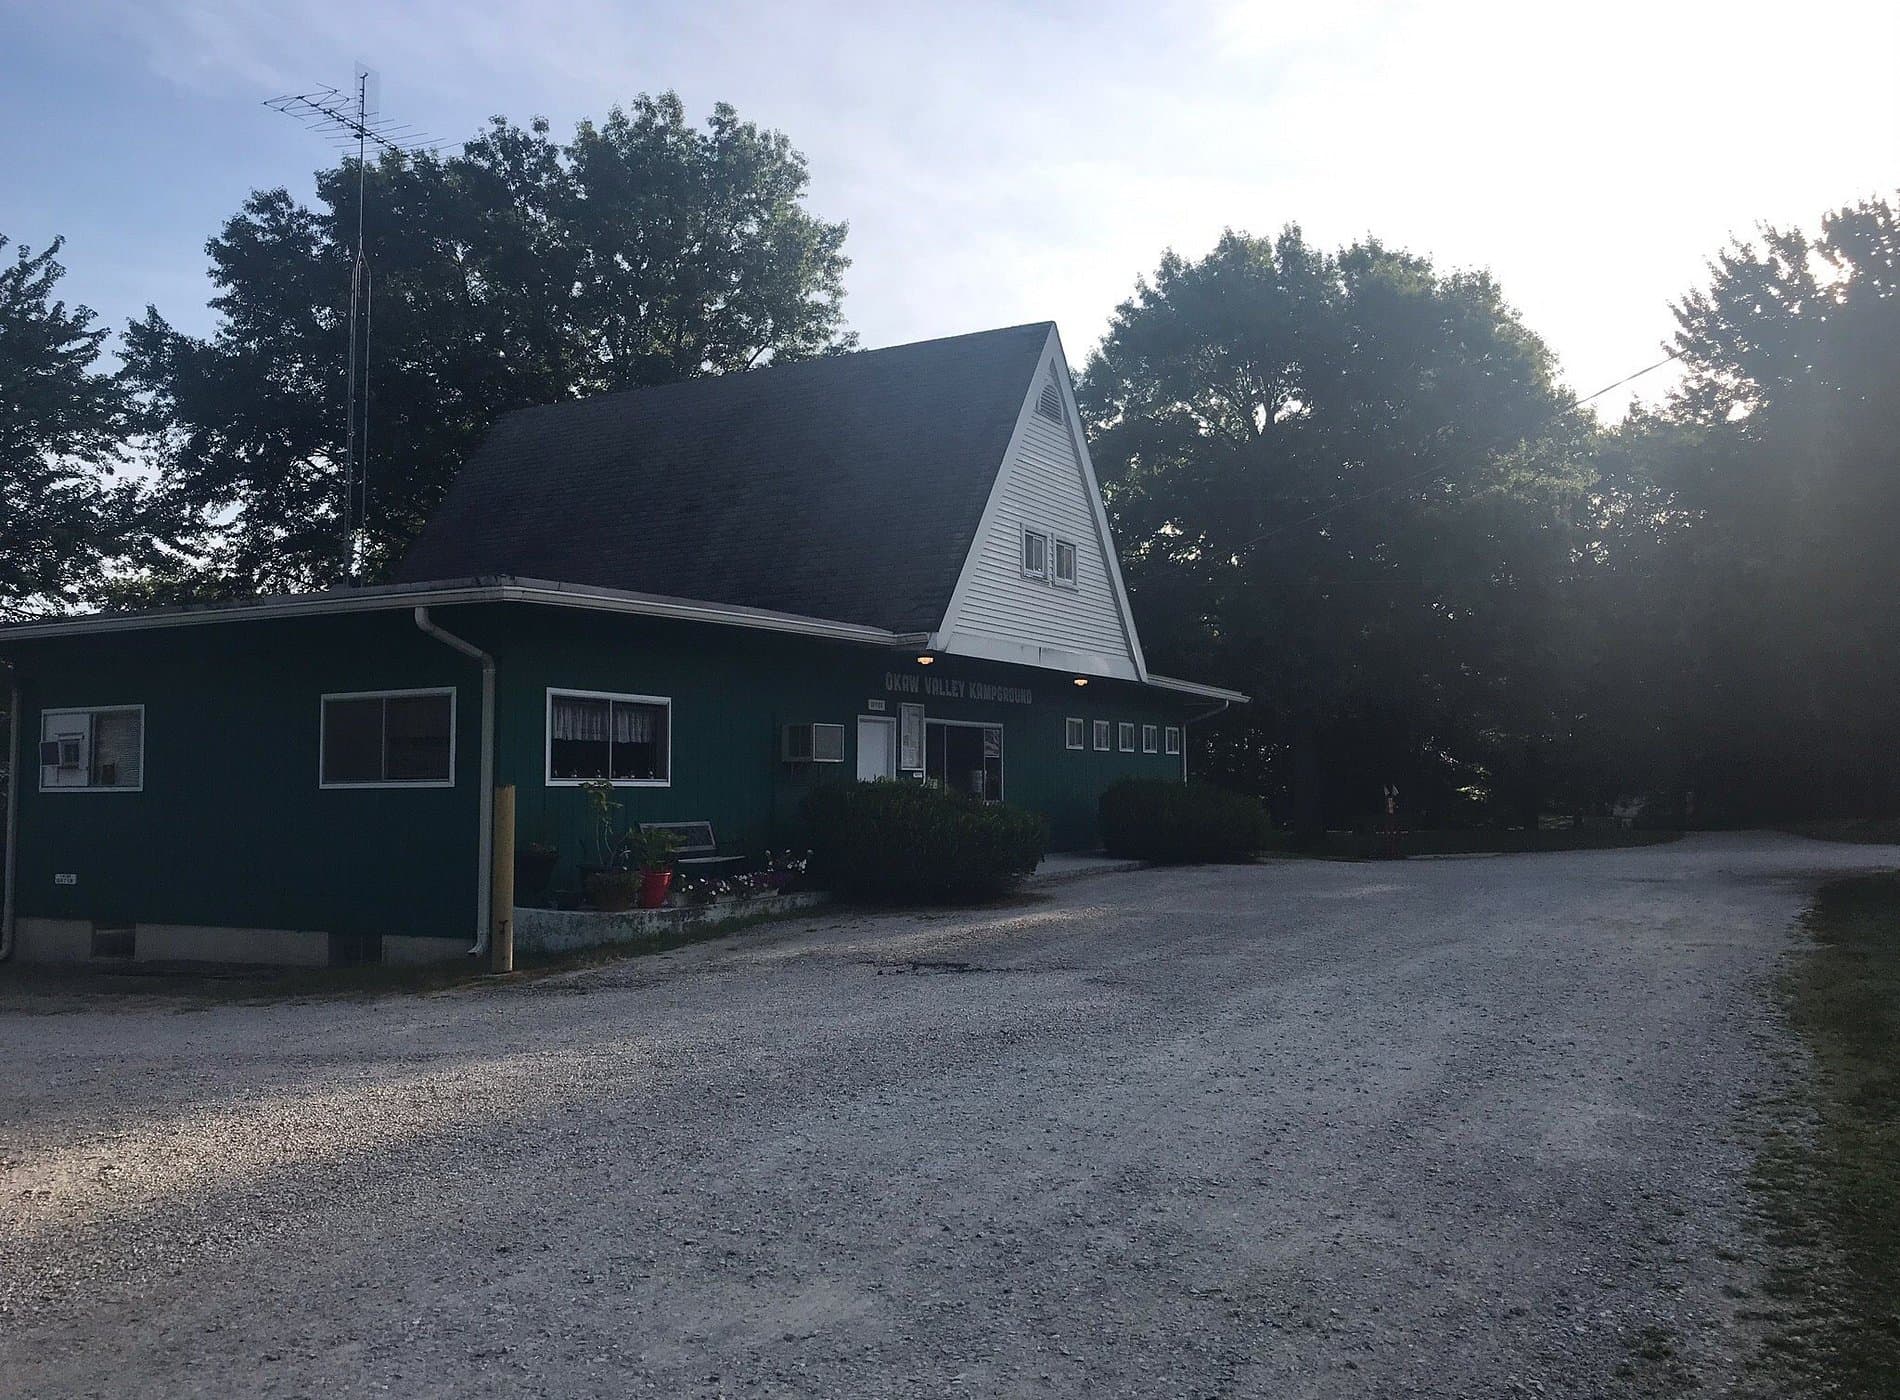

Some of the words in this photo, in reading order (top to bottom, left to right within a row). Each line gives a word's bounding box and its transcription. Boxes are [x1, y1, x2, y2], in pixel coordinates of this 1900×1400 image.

[885, 671, 920, 693] OKAW
[924, 675, 965, 698] VALLEY
[969, 682, 1033, 705] KAMPGROUND
